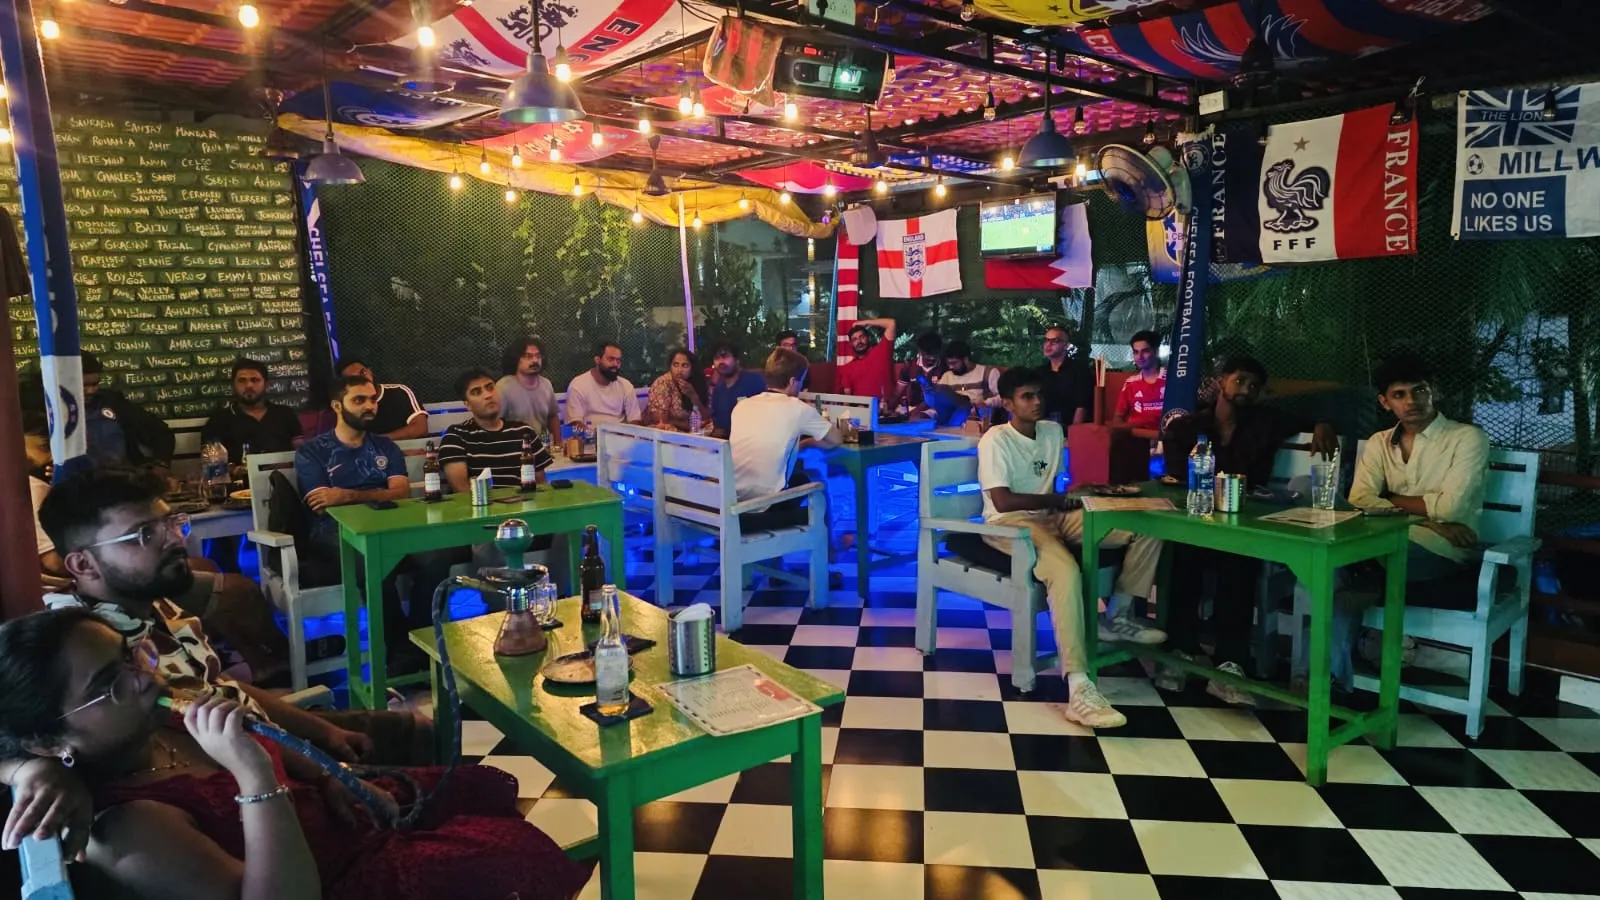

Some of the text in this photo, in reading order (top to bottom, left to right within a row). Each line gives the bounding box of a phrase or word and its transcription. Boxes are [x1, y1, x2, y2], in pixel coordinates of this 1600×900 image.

[1481, 111, 1548, 121] THE LION
[1212, 133, 1226, 240] FRANCE
[1384, 128, 1411, 252] FRANCE
[1471, 191, 1546, 209] NO ONE
[1464, 214, 1553, 232] LIKES US
[1273, 237, 1316, 252] FFF
[1180, 271, 1195, 341] FOOTBALL
[1176, 344, 1189, 378] CLUB
